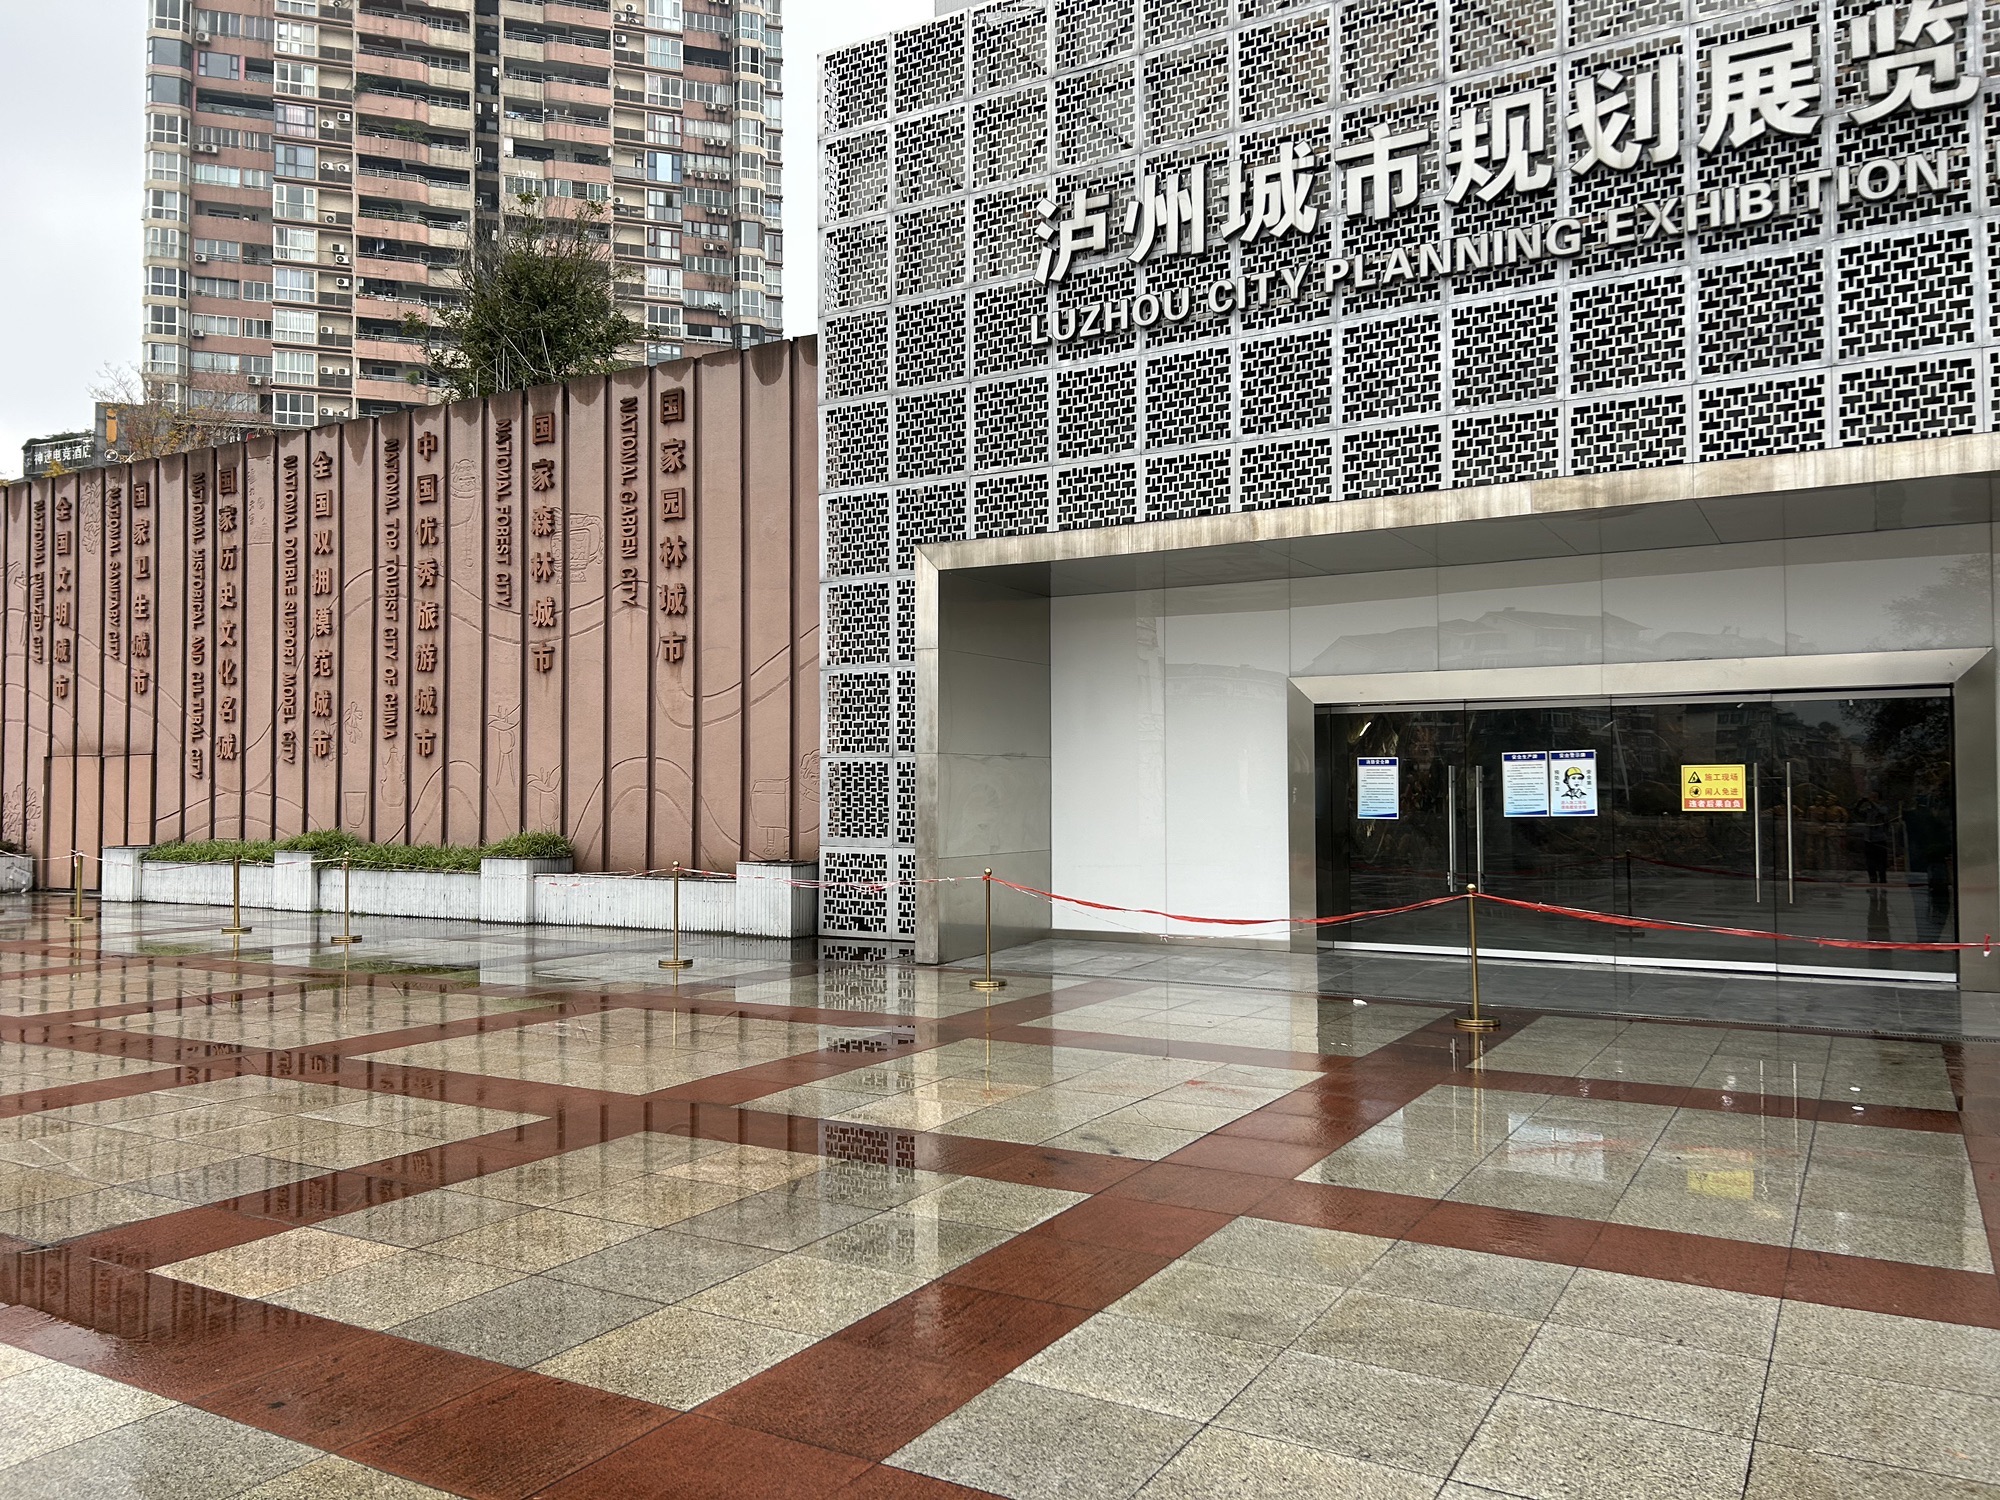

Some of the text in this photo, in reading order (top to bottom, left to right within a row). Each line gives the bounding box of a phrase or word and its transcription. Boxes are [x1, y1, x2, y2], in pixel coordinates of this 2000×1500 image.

[1030, 285, 1192, 347] LUZHOU
[1207, 260, 1313, 315] CITY
[1324, 216, 1583, 294] PLANNING
[1607, 148, 1950, 245] EXHIBITION
[1032, 0, 1982, 287] 泸州城市规划展览
[32, 500, 46, 664] NATIONAL CIVILIZED CITY
[54, 497, 72, 699] 全国文明城市
[107, 486, 122, 661] NATIONAL SANITARY CITY
[133, 482, 150, 695] 国家卫生城市
[311, 450, 333, 759] 全国双拥模范城市
[383, 438, 400, 740] NATIONAL TOP TOURIST CITY OF CHINA
[414, 431, 439, 758] 中国优秀旅游城市
[495, 419, 512, 607] NATIONAL FOREST CITY
[531, 412, 556, 673] 国家森林城市
[620, 396, 638, 606] NATIONAL GARDEN CITY
[659, 386, 687, 663] 国家园林城市
[190, 472, 206, 779] NATIONAL HISTORICAL AND CULTURAL CITY
[216, 467, 238, 760] 国家历史文化名城
[281, 455, 298, 765] NATIONAL DOUBLE SUPPORT MODEL CITY
[1688, 800, 1741, 808] 违者后果自负
[1704, 773, 1739, 782] 施工现场
[1704, 787, 1739, 796] 闲人免进
